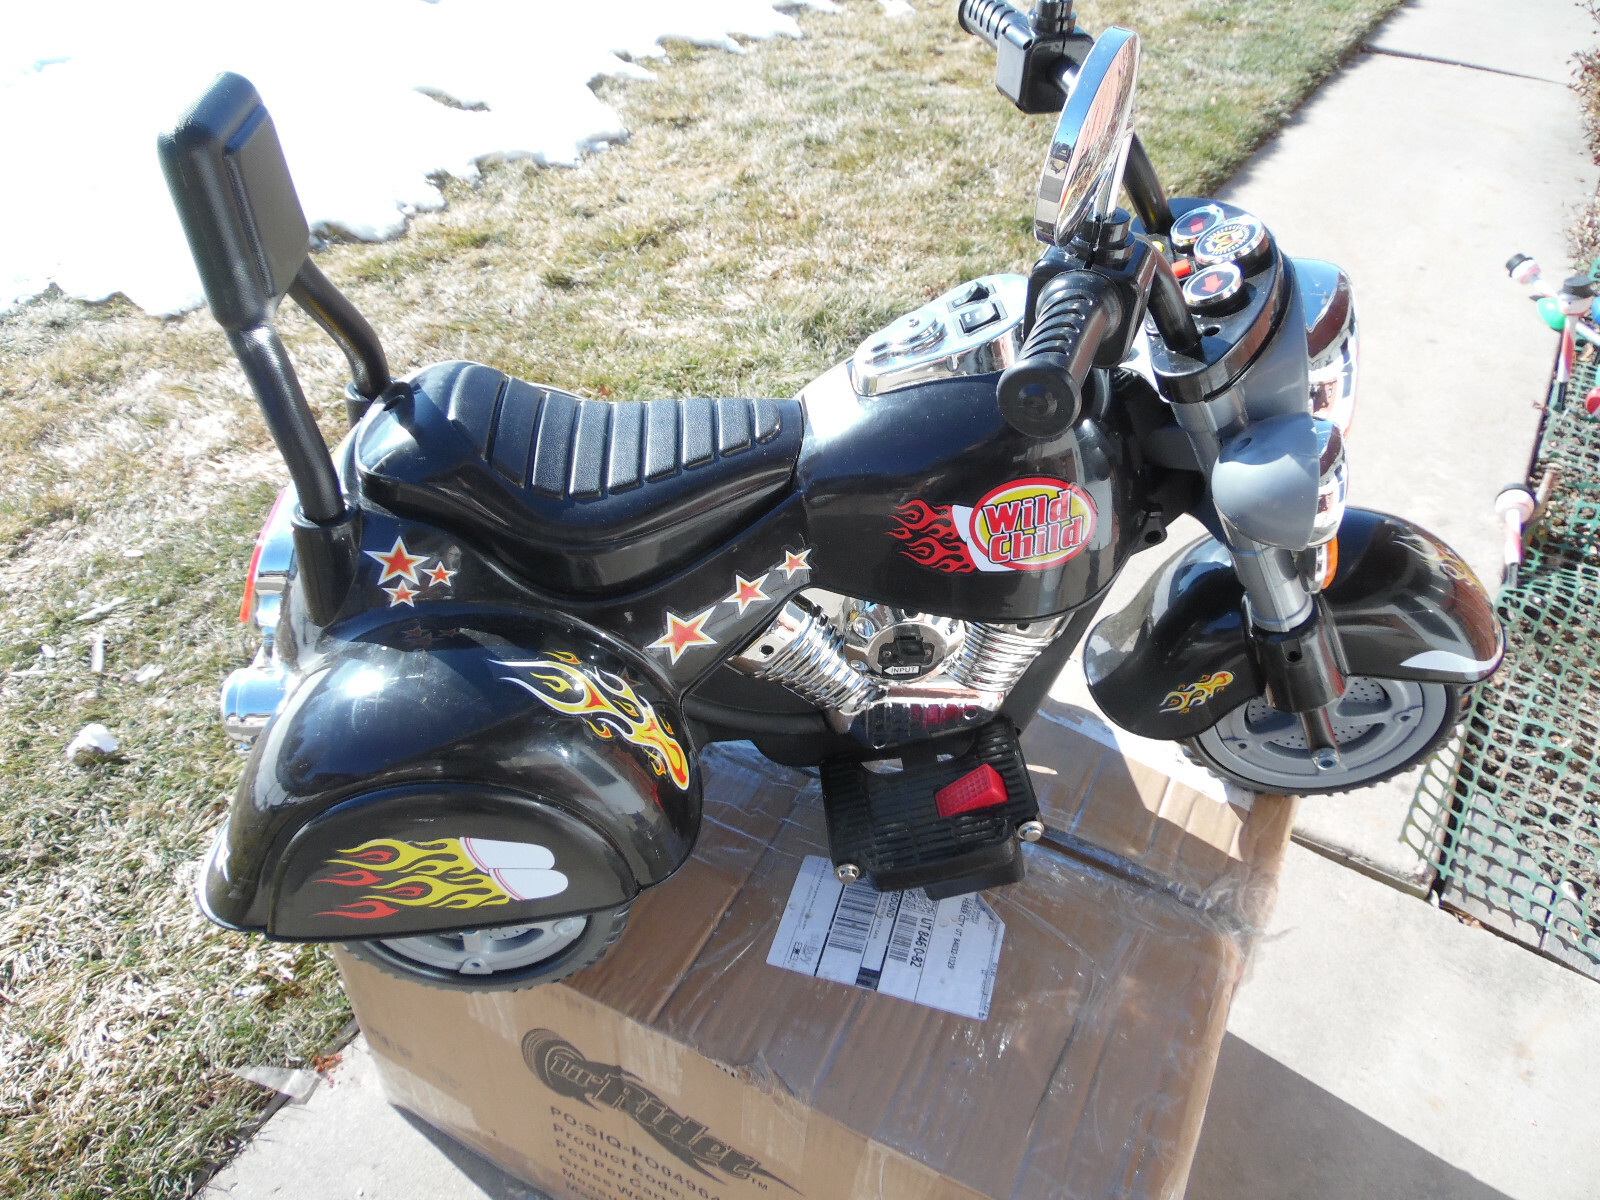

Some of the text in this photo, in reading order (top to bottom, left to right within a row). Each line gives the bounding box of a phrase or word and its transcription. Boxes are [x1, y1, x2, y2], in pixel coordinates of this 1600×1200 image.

[983, 489, 1072, 535] Wild
[986, 515, 1084, 565] Child
[891, 666, 917, 674] INPUT
[920, 917, 933, 931] UT
[552, 1122, 627, 1168] Product
[555, 1138, 588, 1163] Pcs
[593, 1158, 624, 1179] Per
[558, 1154, 612, 1188] Gross
